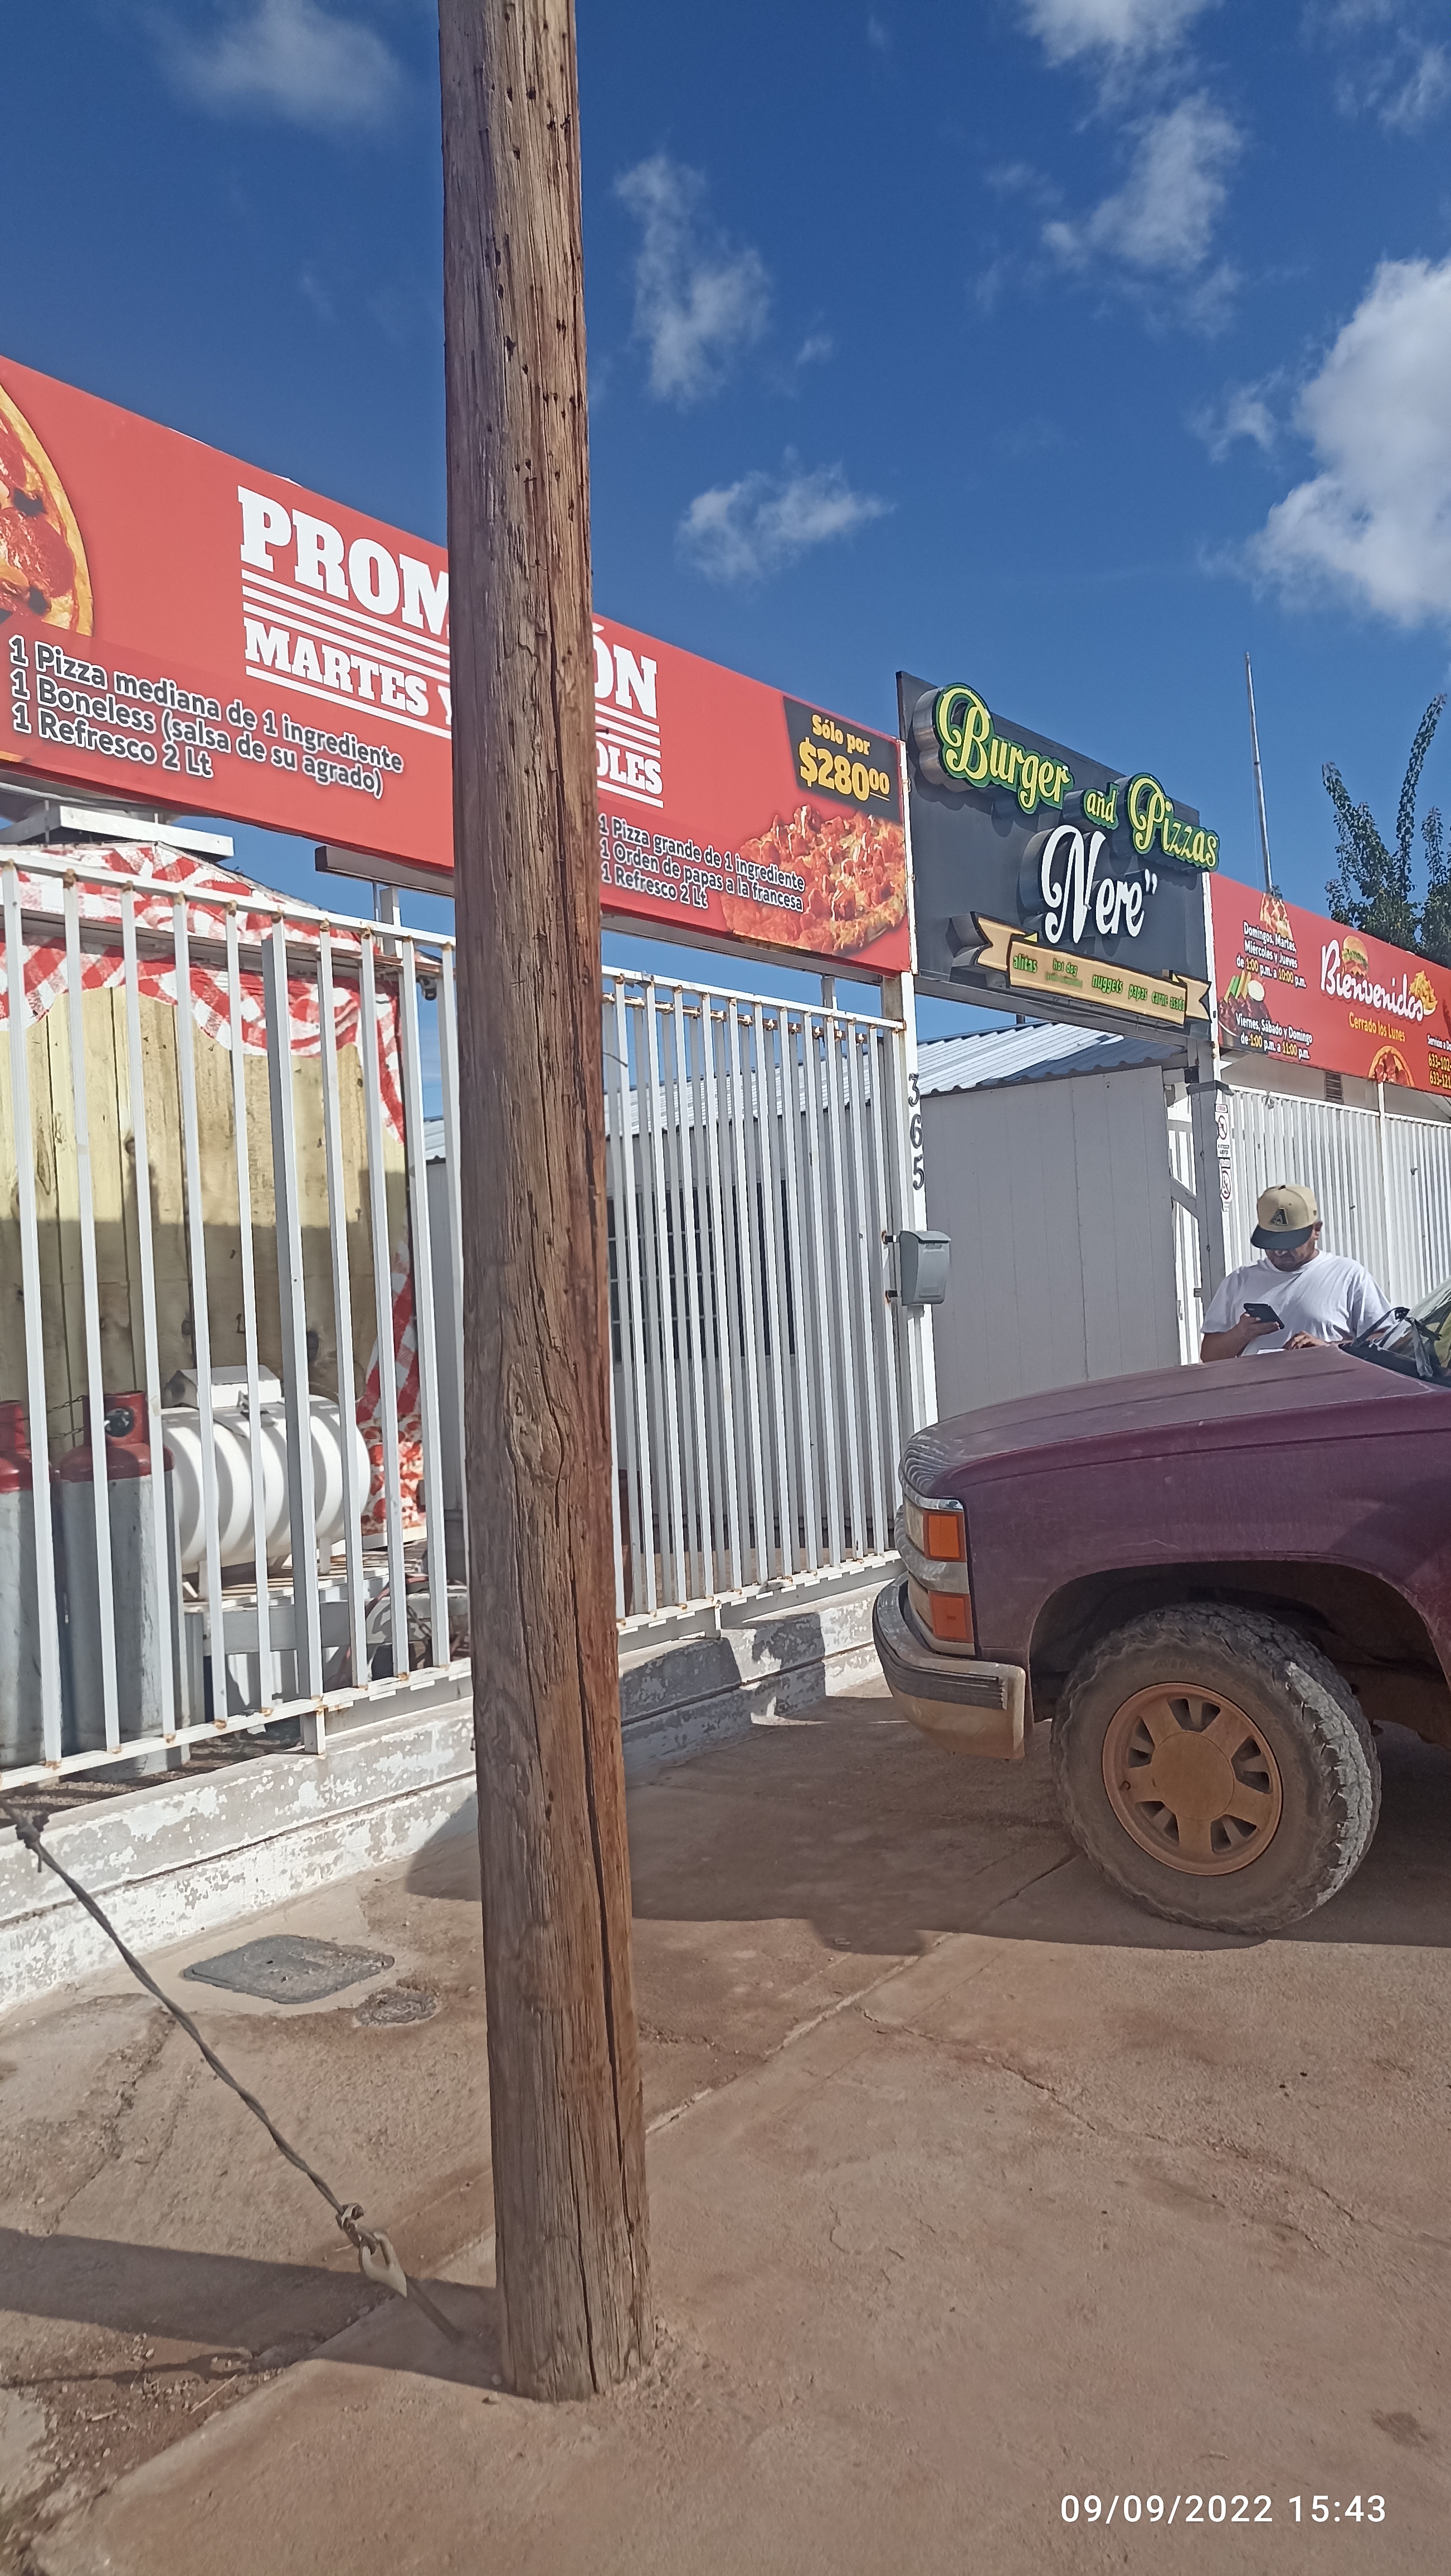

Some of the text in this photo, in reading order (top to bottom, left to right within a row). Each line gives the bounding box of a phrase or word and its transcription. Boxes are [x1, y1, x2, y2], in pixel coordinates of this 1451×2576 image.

[244, 617, 429, 717] MARTES
[9, 635, 404, 773] 1 Pizza mediana de 1 ingrediente
[11, 669, 383, 799] 1 Boneless (salsa de su agrado)
[12, 702, 213, 778] 1 Refresco 2 Lt
[812, 714, 870, 755] Sólo por
[937, 685, 1072, 811] Burger
[1086, 777, 1218, 867] and Pizzas
[598, 813, 805, 892] 1 Pizza grande de 1 ingrediente
[600, 837, 804, 913] 1 Orden de papas a la francesa
[601, 861, 708, 909] 1 Refresco 2 Lt
[1243, 921, 1297, 954] Domingos, Martes,
[1244, 939, 1298, 969] Miércoles y Jueves
[1012, 953, 1038, 973] alitas
[1053, 958, 1078, 977] hot dog
[1236, 954, 1307, 988] de 1:00 p.m. a 10:00 p.m.
[1321, 939, 1423, 1022] Bienvenidos
[1092, 974, 1123, 994] nuggets
[1128, 983, 1148, 1001] papas
[1235, 1012, 1313, 1046] Viernes, Sábado y Domingo
[1240, 1032, 1249, 1045] de
[1264, 1040, 1276, 1052] p.m.
[1277, 1043, 1281, 1052] a
[1282, 1041, 1297, 1056] 11:00
[1298, 1048, 1310, 1060] p.m.
[1348, 1011, 1405, 1042] Cerrado los Lunes
